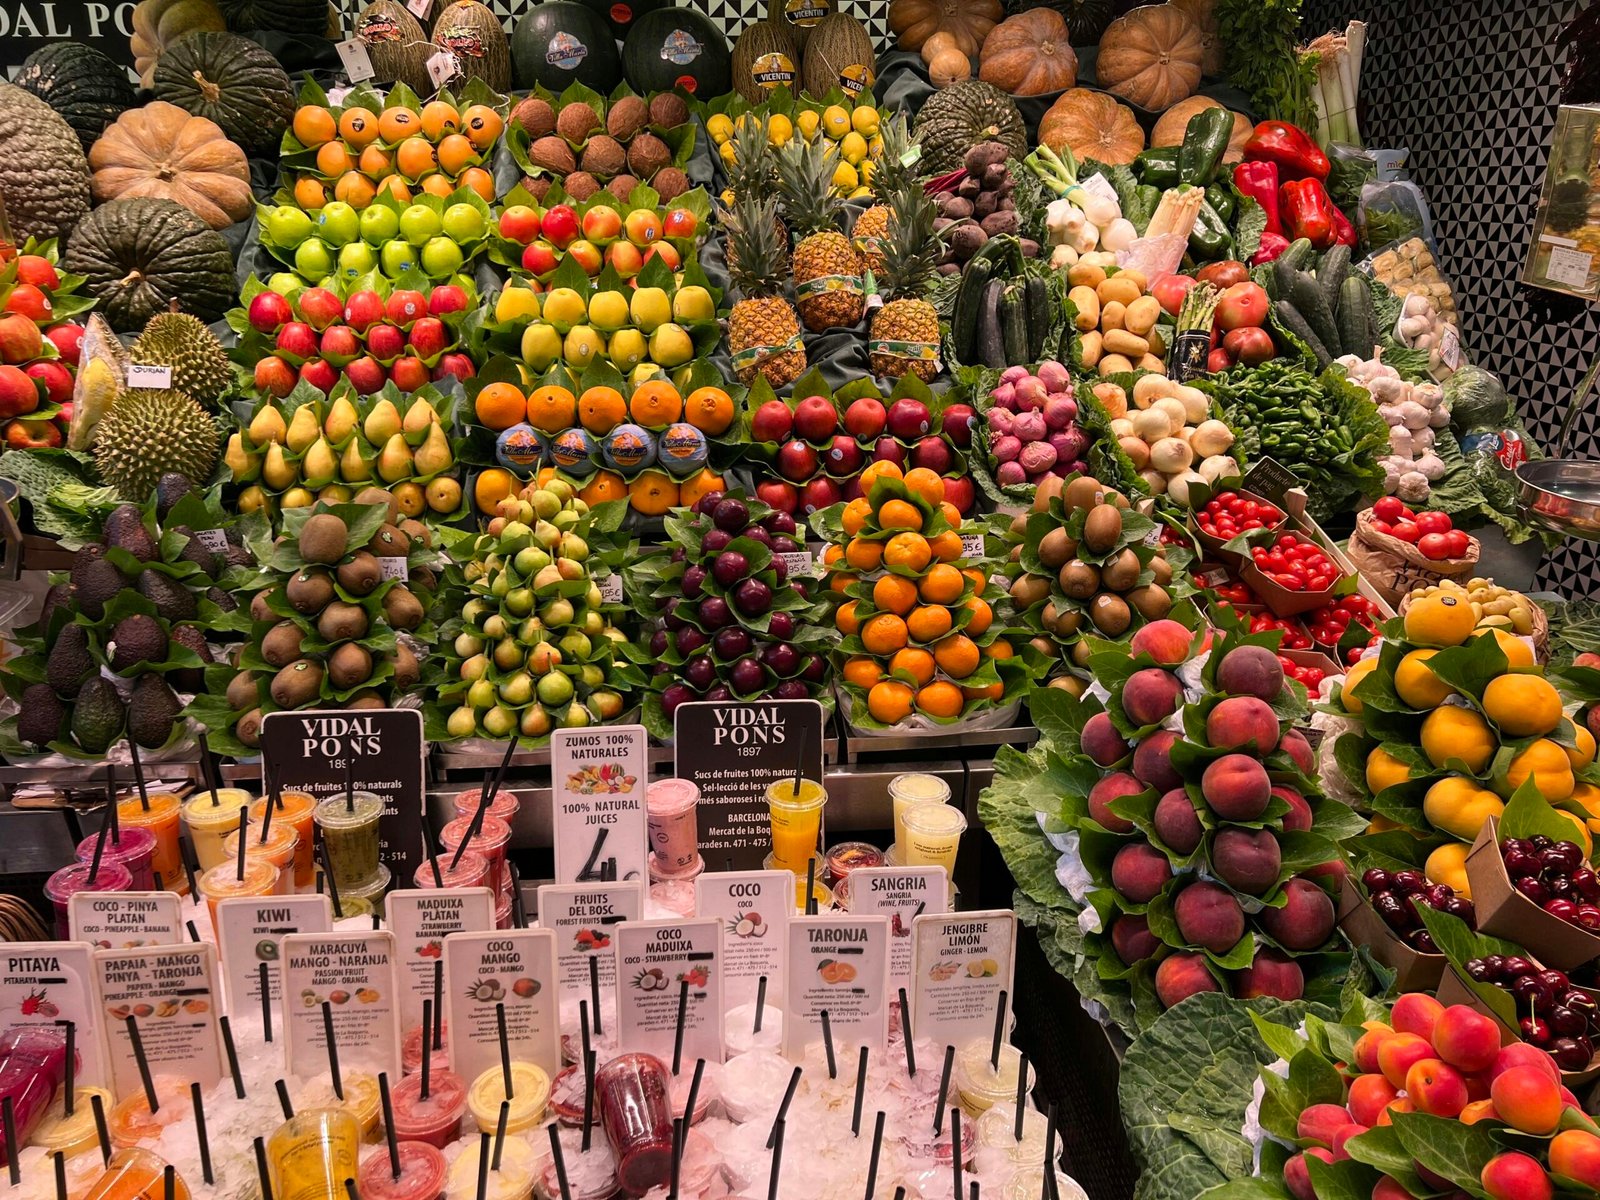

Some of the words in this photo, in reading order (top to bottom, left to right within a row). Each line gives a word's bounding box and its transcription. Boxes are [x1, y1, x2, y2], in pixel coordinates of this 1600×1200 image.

[794, 8, 823, 18] VICENTIN
[761, 72, 790, 82] VICENTIN
[714, 708, 785, 725] VIDAL
[302, 718, 380, 737] VIDAL
[566, 736, 600, 746] ZUMOS
[606, 735, 633, 744] 100%
[714, 726, 785, 745] PONS
[572, 747, 628, 759] NATURALES
[738, 747, 761, 756] 1897
[695, 771, 711, 779] Sucs
[713, 770, 722, 778] de
[751, 769, 771, 777] 100%
[303, 783, 313, 791] de
[315, 783, 342, 791] fruites
[368, 780, 402, 789] naturals
[740, 782, 748, 790] de
[751, 782, 761, 790] les
[699, 796, 715, 804] més
[716, 796, 752, 804] saboroses
[563, 803, 590, 814] 100%
[596, 800, 639, 811] NATURAL
[586, 814, 617, 825] JUICES
[728, 814, 771, 823] BARCELONA
[748, 826, 754, 834] la
[698, 840, 723, 849] arades
[733, 839, 746, 847] 471
[392, 852, 406, 860] 514
[872, 877, 926, 891] SANGRIA
[729, 883, 760, 897] COCO
[418, 899, 463, 909] MADUIXA
[575, 894, 608, 904] FRUITS
[93, 901, 118, 911] COCO
[128, 902, 157, 911] PINYA
[569, 907, 586, 916] DEL
[590, 905, 613, 915] BOSC
[257, 909, 290, 922] KIWI
[422, 922, 461, 930] STRAWBERRY
[942, 924, 988, 934] JENGIBRE
[657, 929, 681, 940] COCO
[808, 929, 868, 942] TARONJA
[949, 935, 980, 946] LIMÓN
[310, 943, 367, 955] MARACUYÁ
[487, 941, 513, 952] COCO
[646, 940, 692, 953] MADUIXA
[941, 948, 962, 956] GINGER
[106, 959, 147, 971] PAPAIA
[157, 953, 199, 967] MANGO
[291, 957, 329, 968] MANGO
[340, 955, 388, 966] NARANJA
[482, 953, 520, 964] MANGO
[646, 954, 686, 963] STRAWBERRY
[9, 958, 60, 972] PITAYA
[106, 972, 140, 983] PINYA
[152, 966, 203, 979] TARONJA
[315, 969, 343, 977] PASSION
[127, 983, 153, 991] PAPAYA
[159, 980, 184, 988] MANGO
[342, 976, 368, 984] ORANGE
[104, 992, 143, 1001] PINEAPPLE
